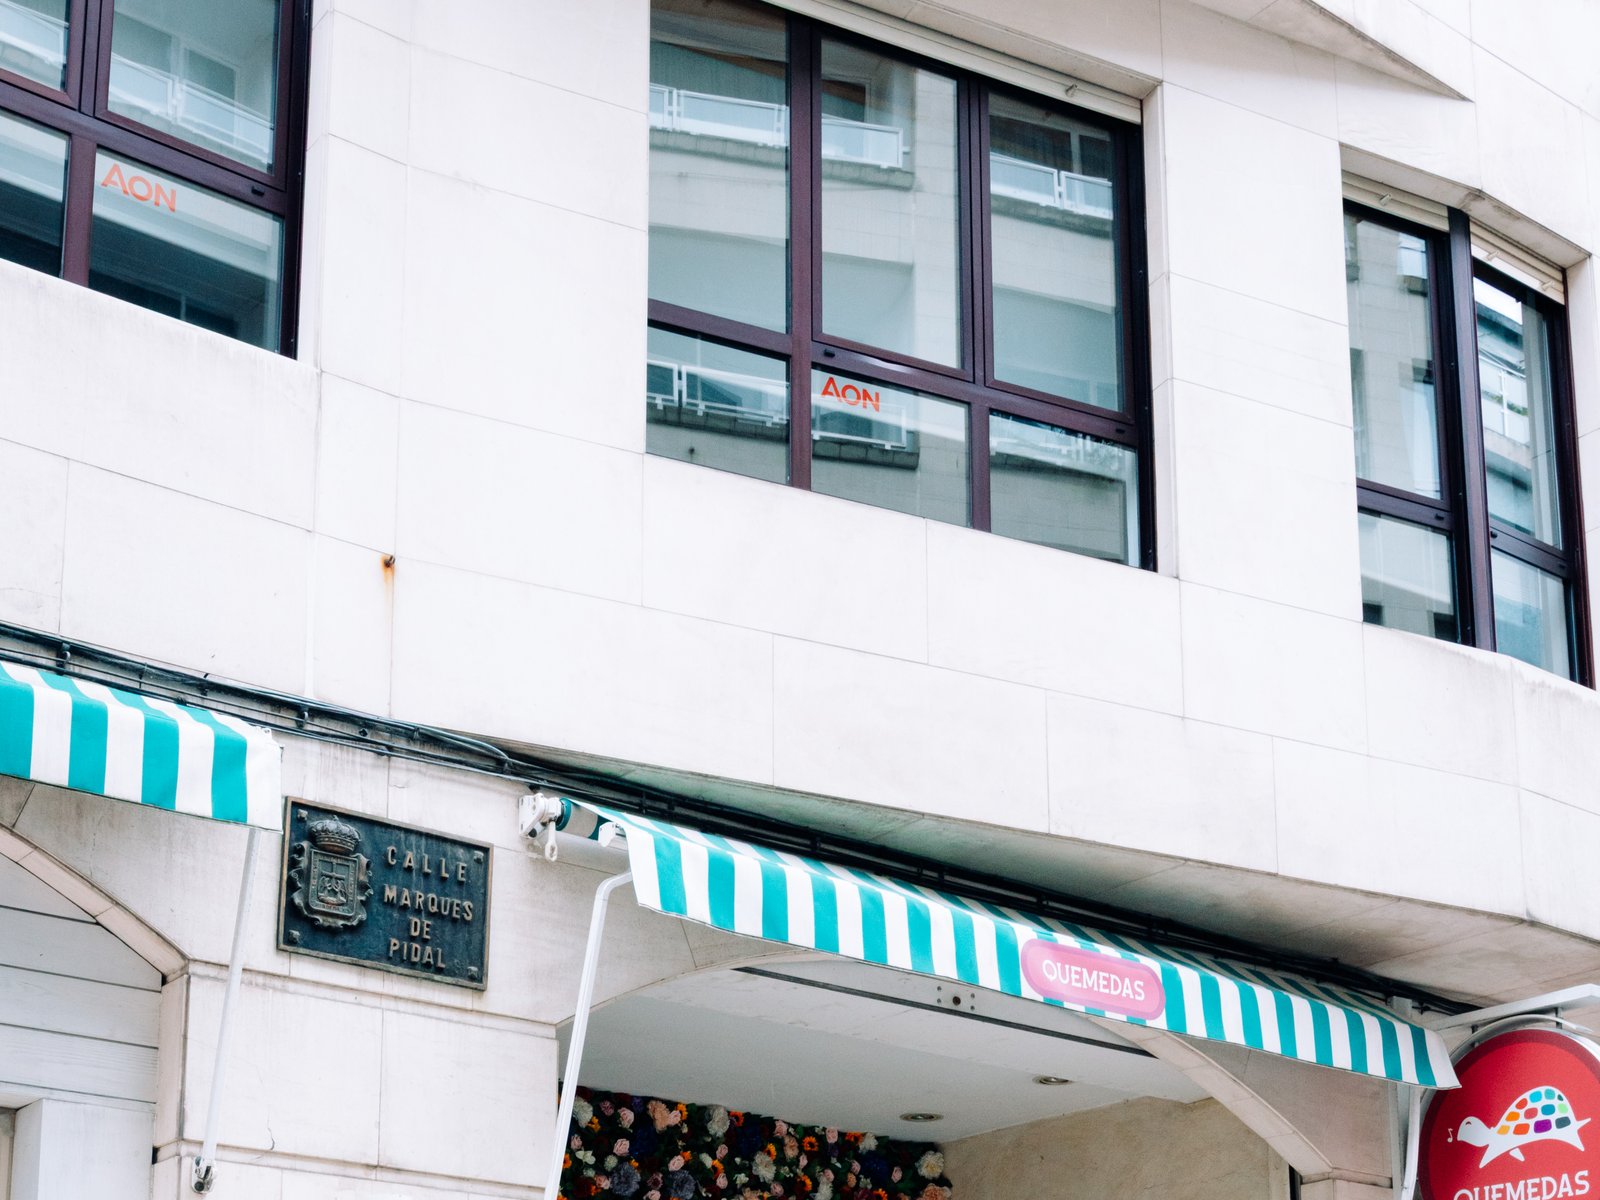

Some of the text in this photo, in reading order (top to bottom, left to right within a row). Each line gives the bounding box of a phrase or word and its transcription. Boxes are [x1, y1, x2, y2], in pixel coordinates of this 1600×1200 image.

[101, 163, 176, 212] AON
[821, 376, 880, 412] AON
[386, 845, 467, 882] CALLE
[383, 883, 474, 921] MARQUES
[409, 917, 432, 940] DE
[389, 937, 446, 969] PIDAL
[1042, 959, 1145, 1001] QUEMEDAS
